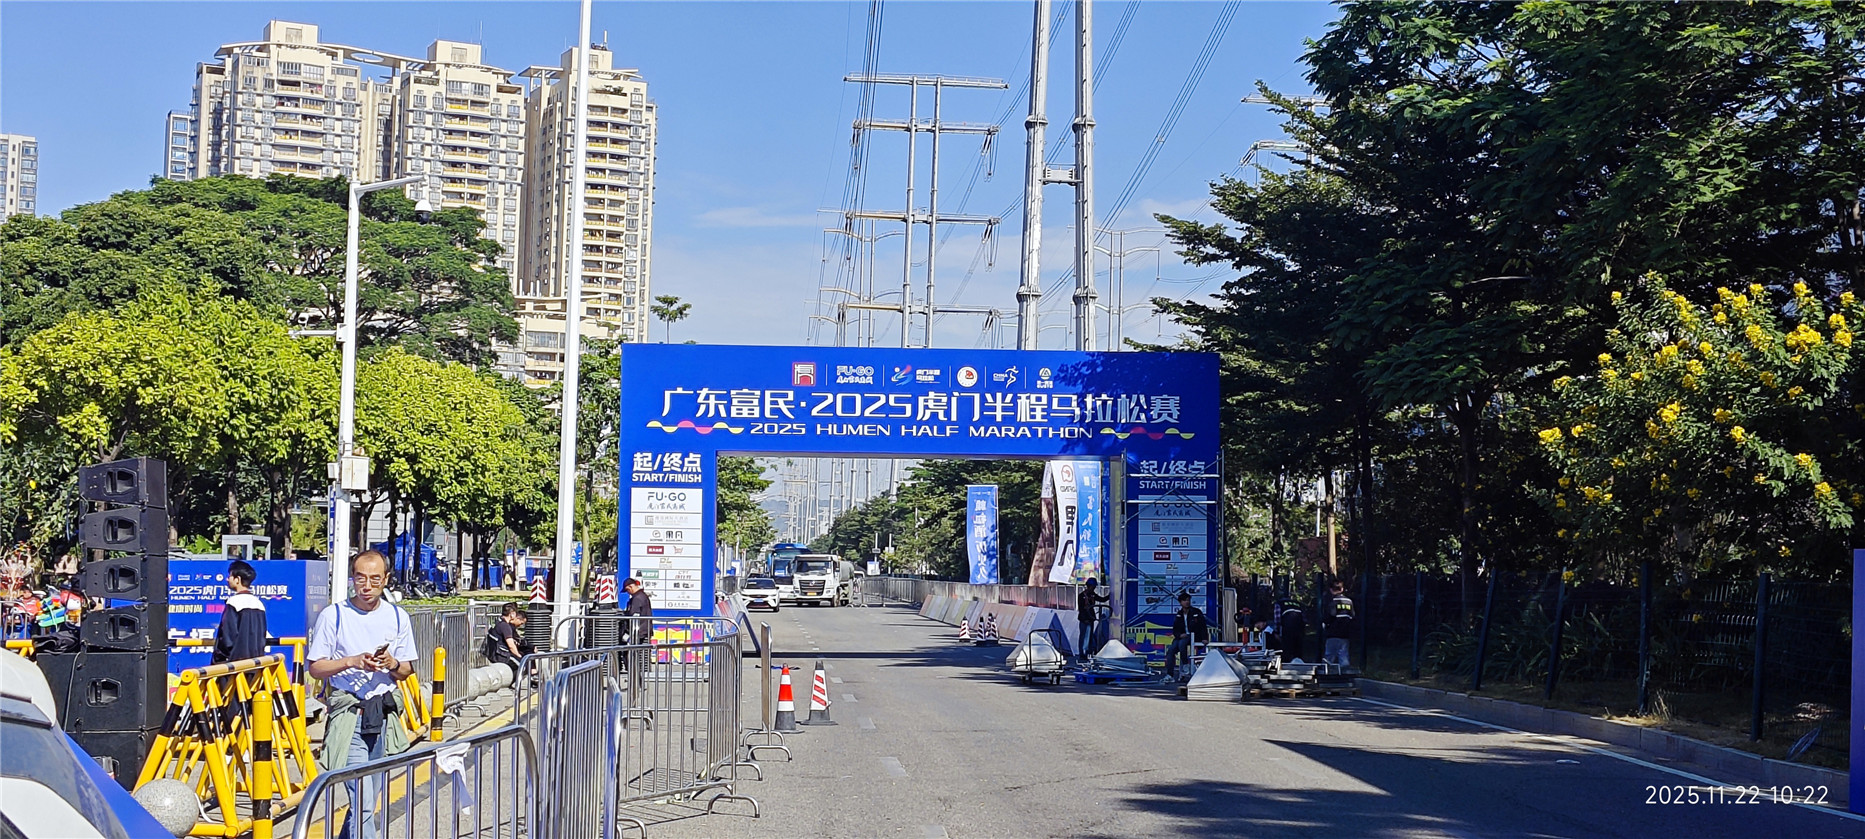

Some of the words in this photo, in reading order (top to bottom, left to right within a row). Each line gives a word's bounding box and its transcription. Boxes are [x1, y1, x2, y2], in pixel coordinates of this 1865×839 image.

[661, 387, 1181, 424] 广东富民·2025虎门半程马拉松赛
[750, 424, 806, 435] 2025
[816, 424, 890, 436] HUMEN
[901, 425, 959, 437] HALF
[969, 426, 1093, 439] MARATHON
[632, 452, 702, 472] 起/终点
[631, 472, 703, 484] START/FINISH
[1139, 481, 1207, 490] START/FINISH
